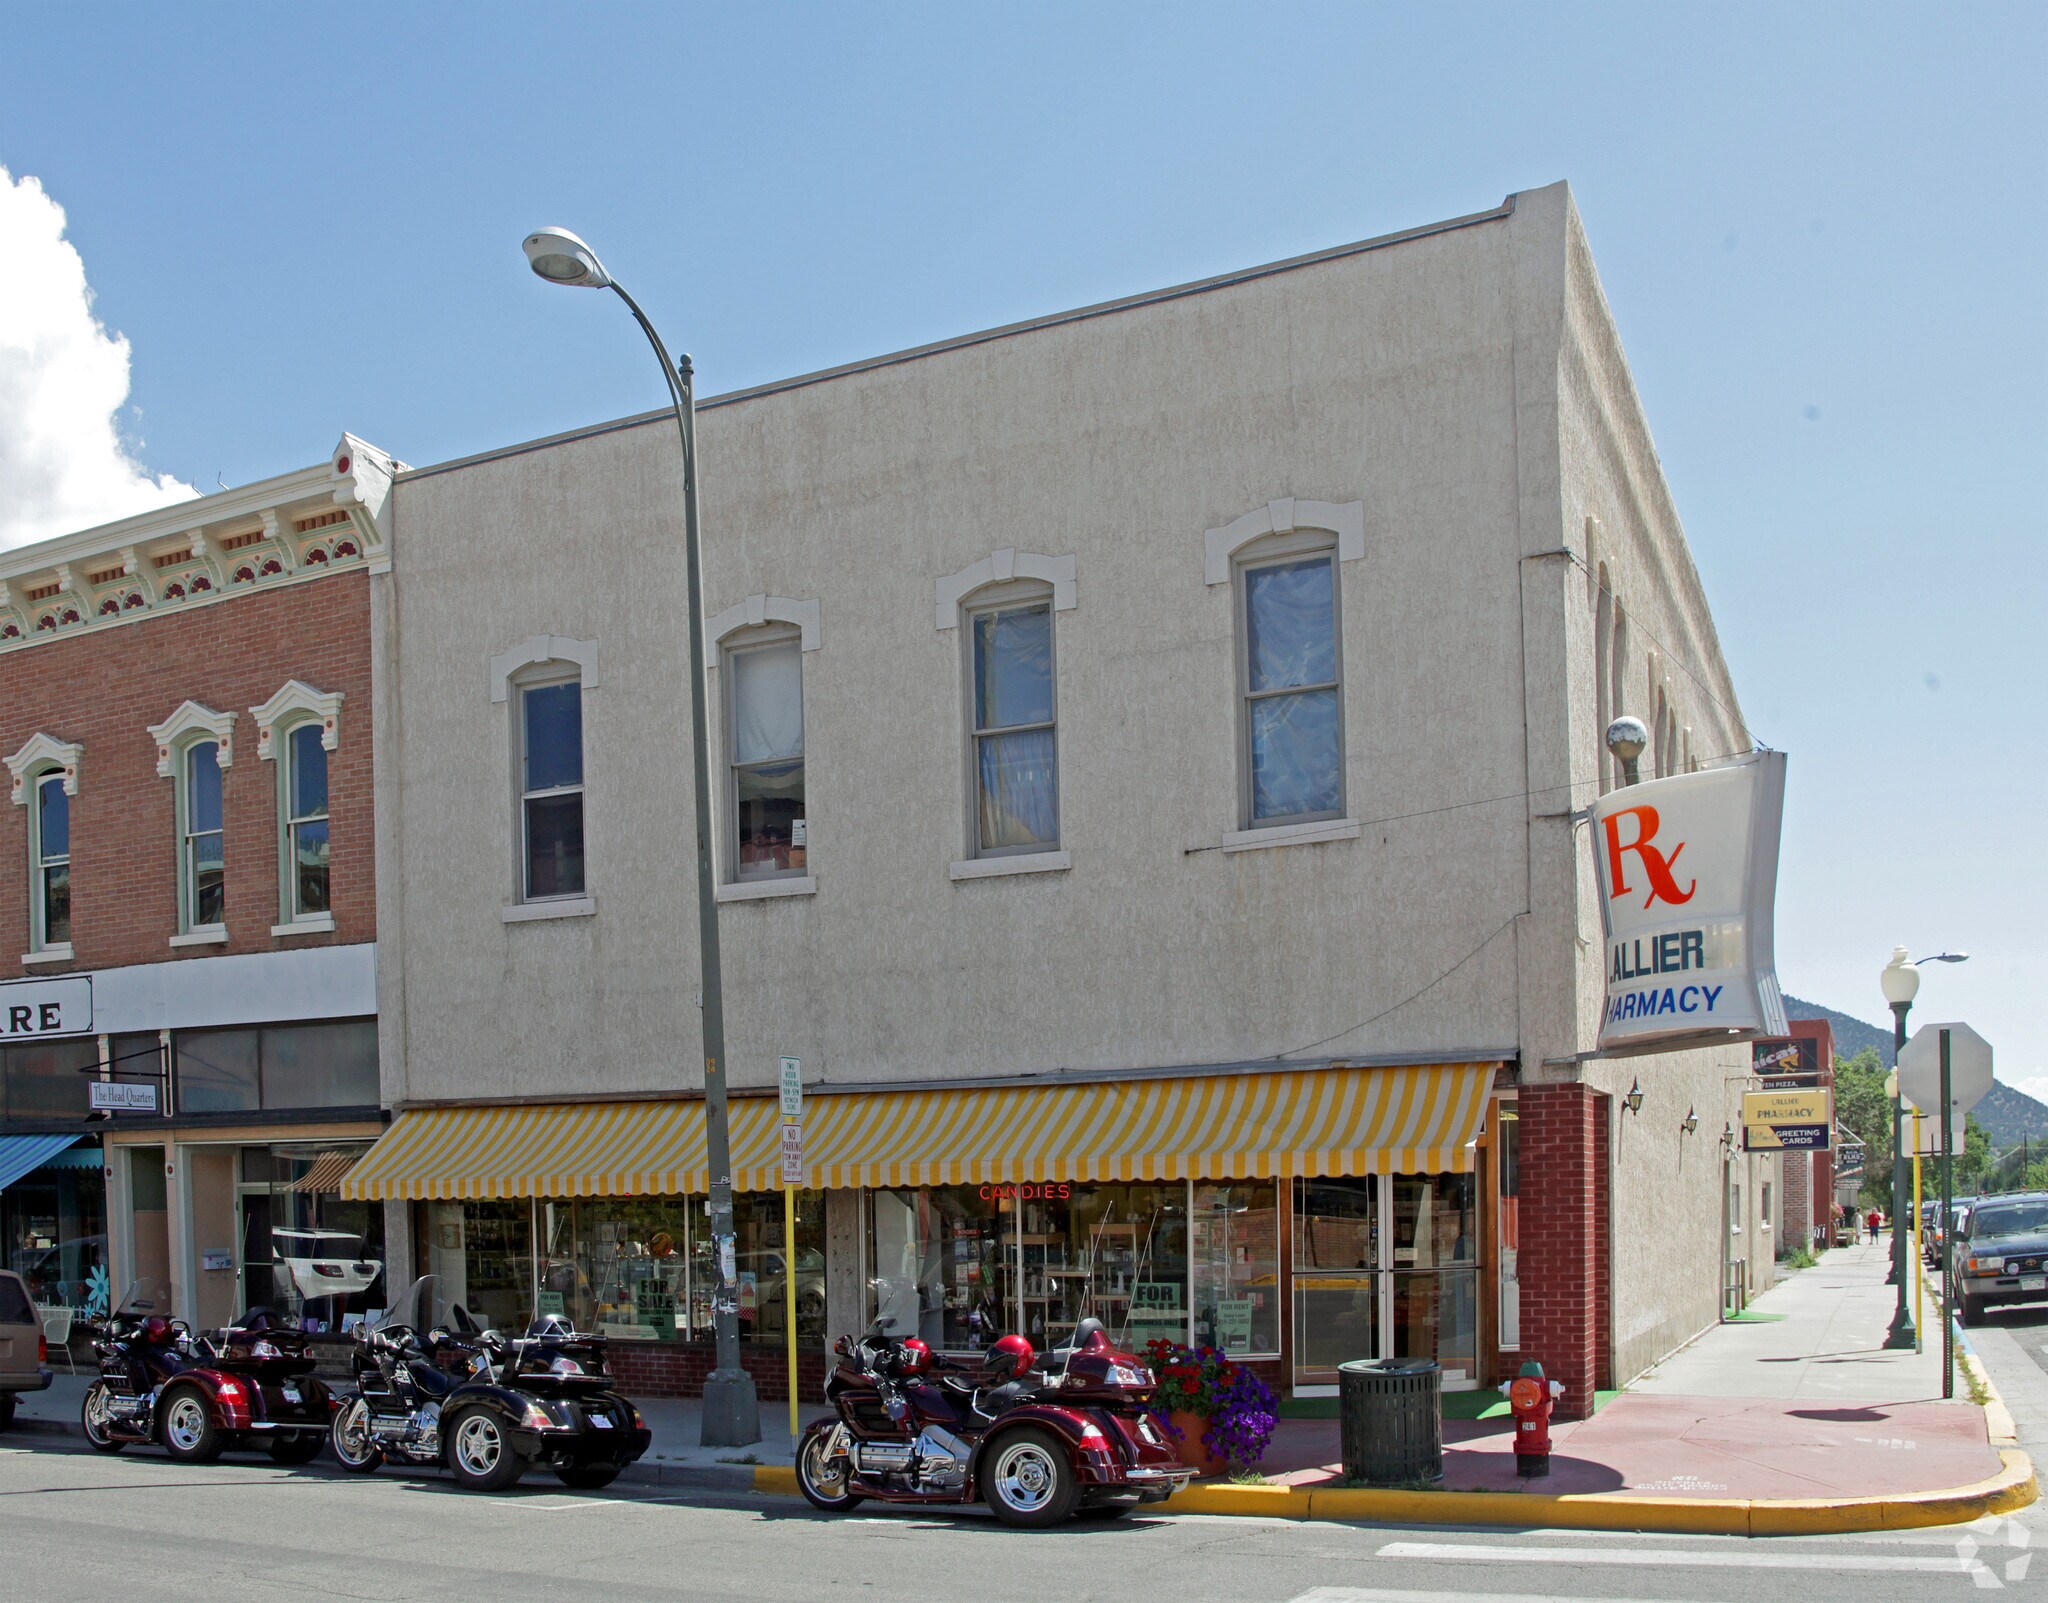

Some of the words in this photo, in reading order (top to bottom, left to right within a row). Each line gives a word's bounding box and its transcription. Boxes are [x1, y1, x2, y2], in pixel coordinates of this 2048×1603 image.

[1601, 804, 1697, 910] Rx
[1610, 929, 1704, 984] ALLIER
[1609, 985, 1723, 1025] HARMACY
[0, 1002, 61, 1033] RE
[786, 1062, 795, 1070] TWO
[785, 1071, 796, 1079] HOUR
[783, 1079, 800, 1087] PARKING
[94, 1085, 107, 1102] The
[108, 1084, 125, 1103] Head
[126, 1087, 154, 1105] Quarters
[1757, 1108, 1814, 1119] PHARMACY
[787, 1129, 796, 1140] NO
[1776, 1129, 1820, 1137] GREETING
[783, 1141, 801, 1152] PARKING
[787, 1161, 797, 1169] ZONE
[980, 1185, 1070, 1200] CANDIES
[641, 1280, 668, 1293] FOR
[1136, 1285, 1173, 1301] FOR
[638, 1294, 673, 1309] SALE
[1133, 1302, 1179, 1318] SALE
